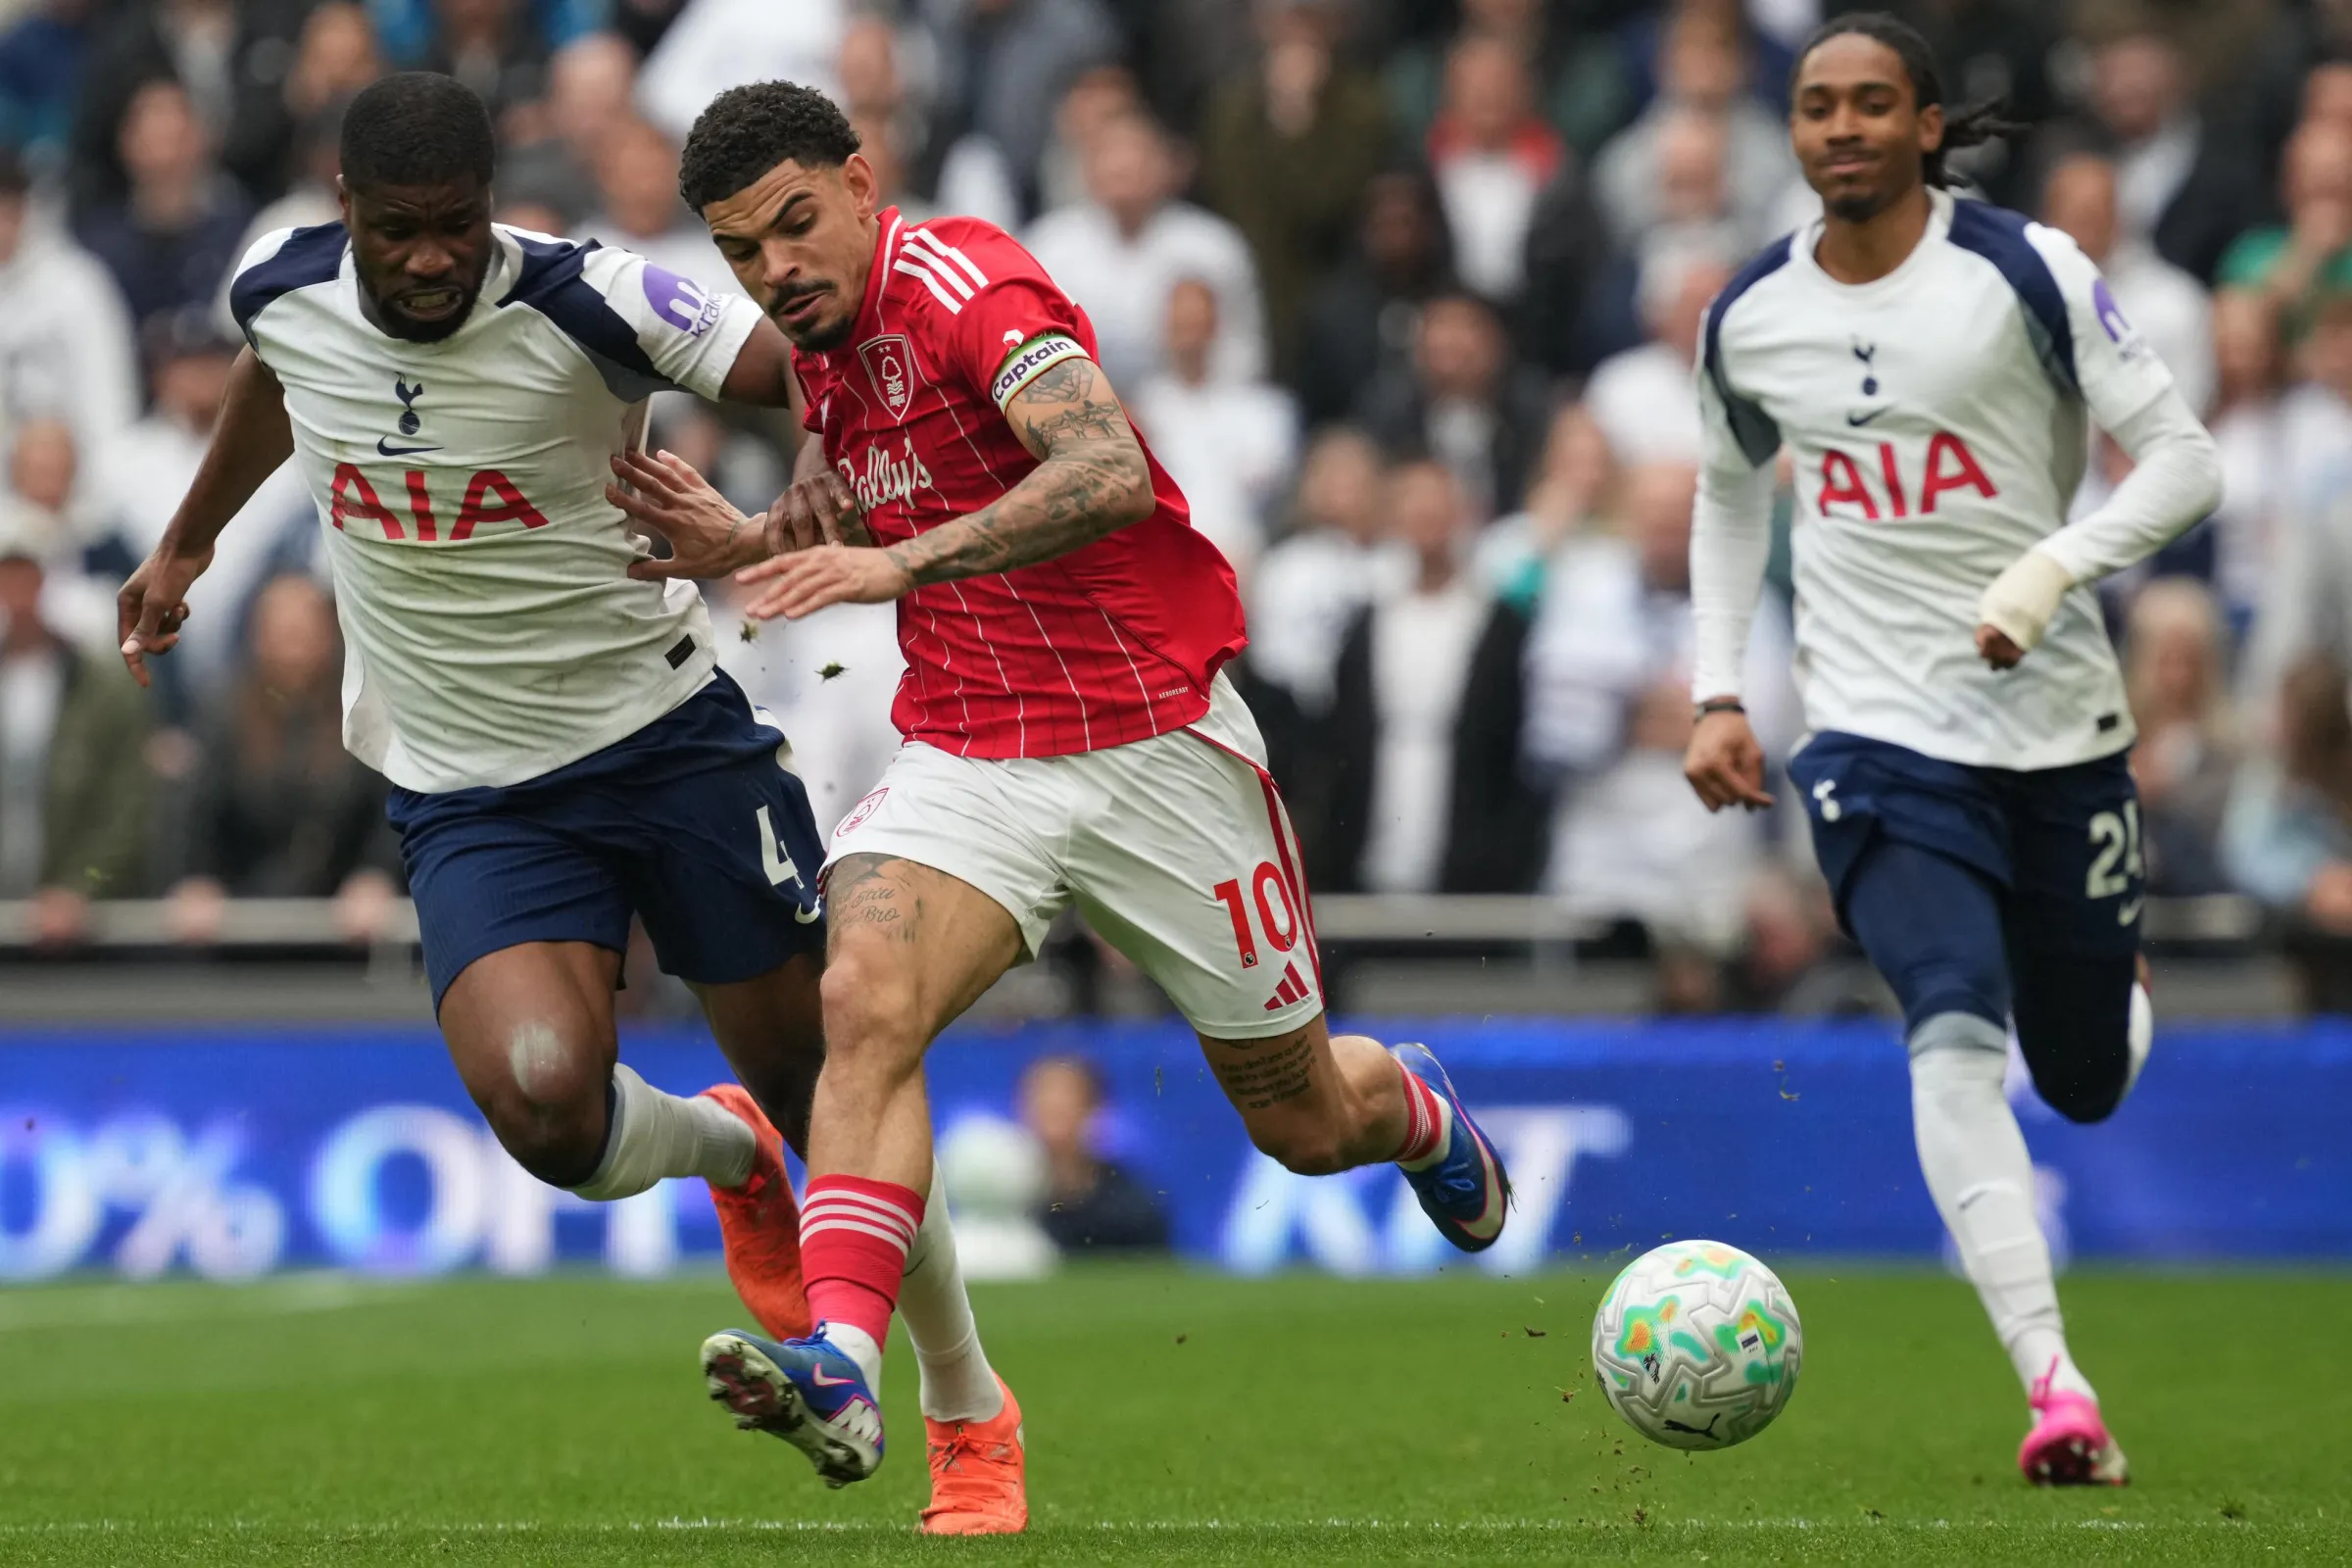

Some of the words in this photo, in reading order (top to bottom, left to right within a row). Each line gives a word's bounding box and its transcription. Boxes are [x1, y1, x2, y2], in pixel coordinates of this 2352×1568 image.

[993, 340, 1072, 401] Captain
[330, 463, 550, 542] AIA
[1818, 428, 2000, 521] AIA
[756, 805, 805, 890] 4
[1213, 860, 1298, 969] 10
